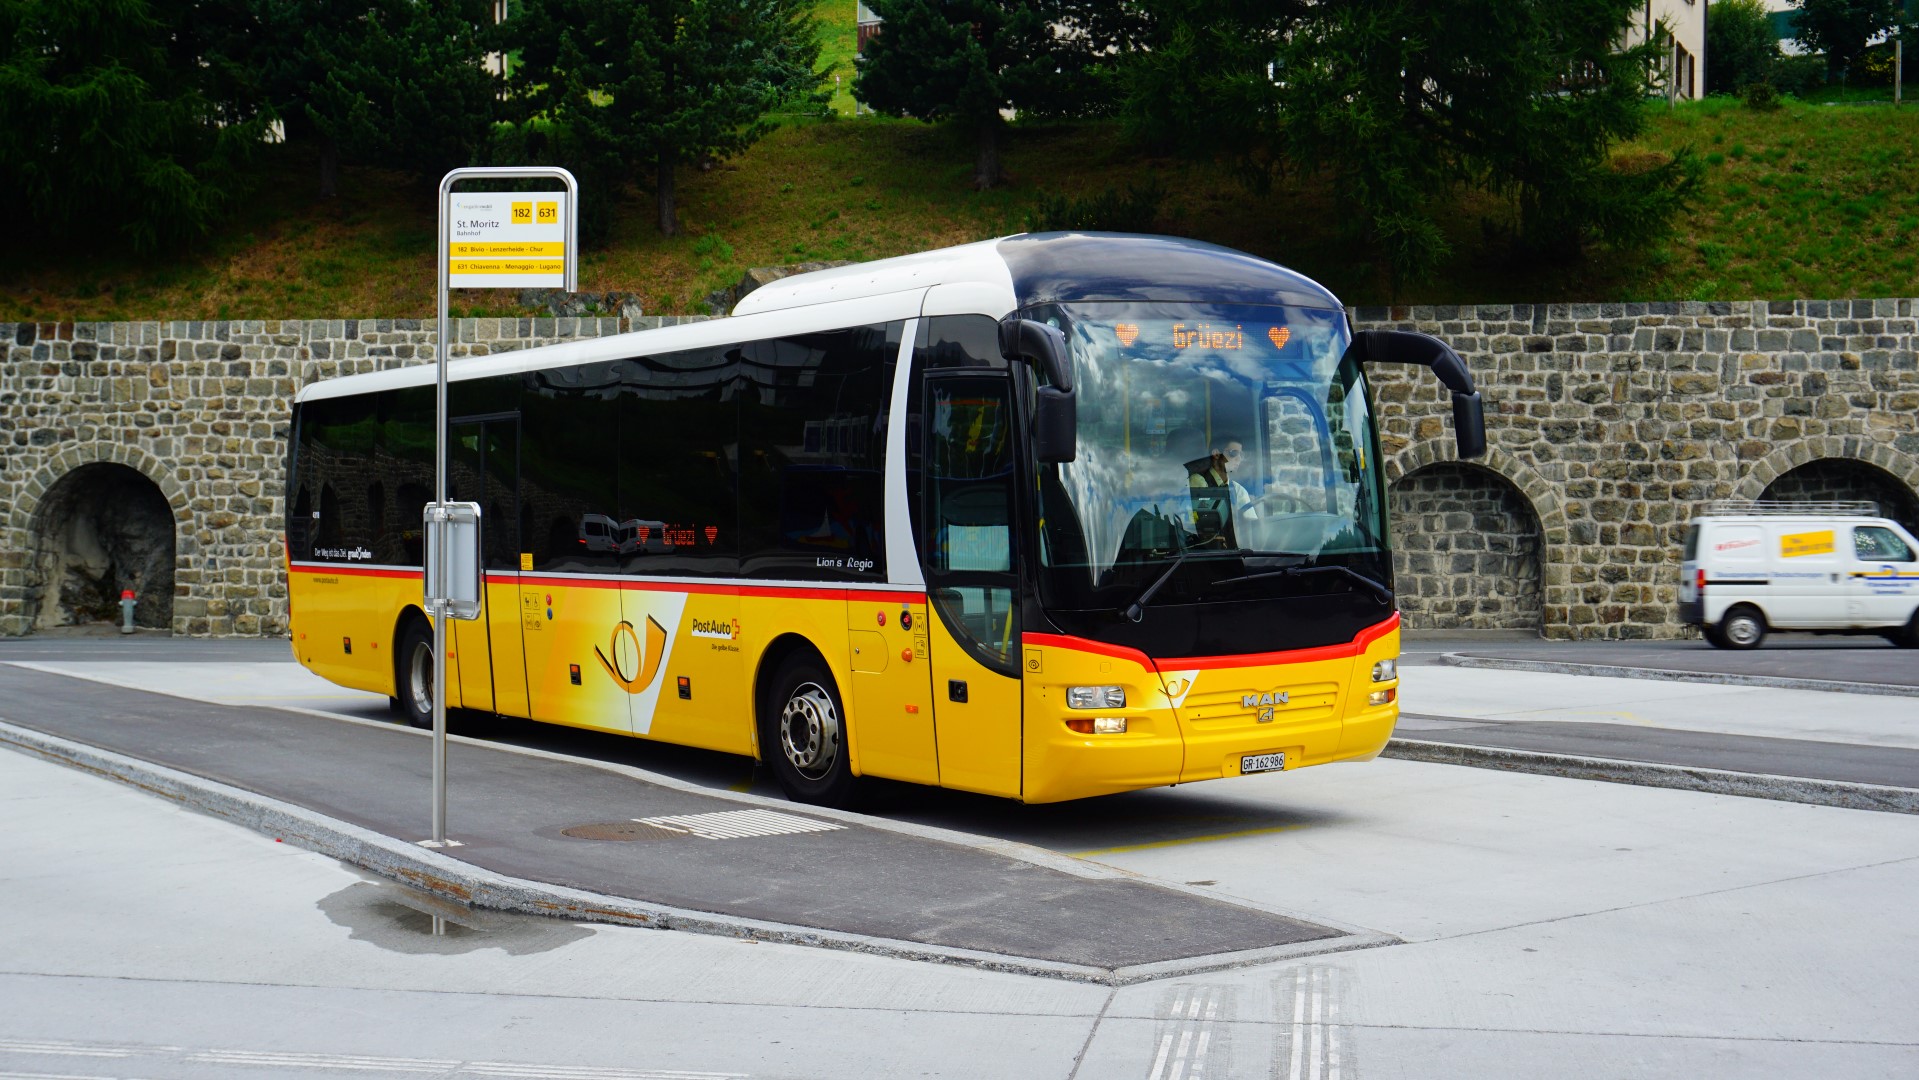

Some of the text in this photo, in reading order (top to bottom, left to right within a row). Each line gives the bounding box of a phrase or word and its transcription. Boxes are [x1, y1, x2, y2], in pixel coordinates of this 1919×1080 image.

[513, 208, 556, 218] 182 631
[457, 219, 500, 228] St. Moritz
[505, 263, 535, 271] Menaggio
[1172, 323, 1244, 350] Grüezi
[847, 557, 874, 572] Regio
[692, 617, 731, 636] PostAuto
[1242, 691, 1289, 708] MAN
